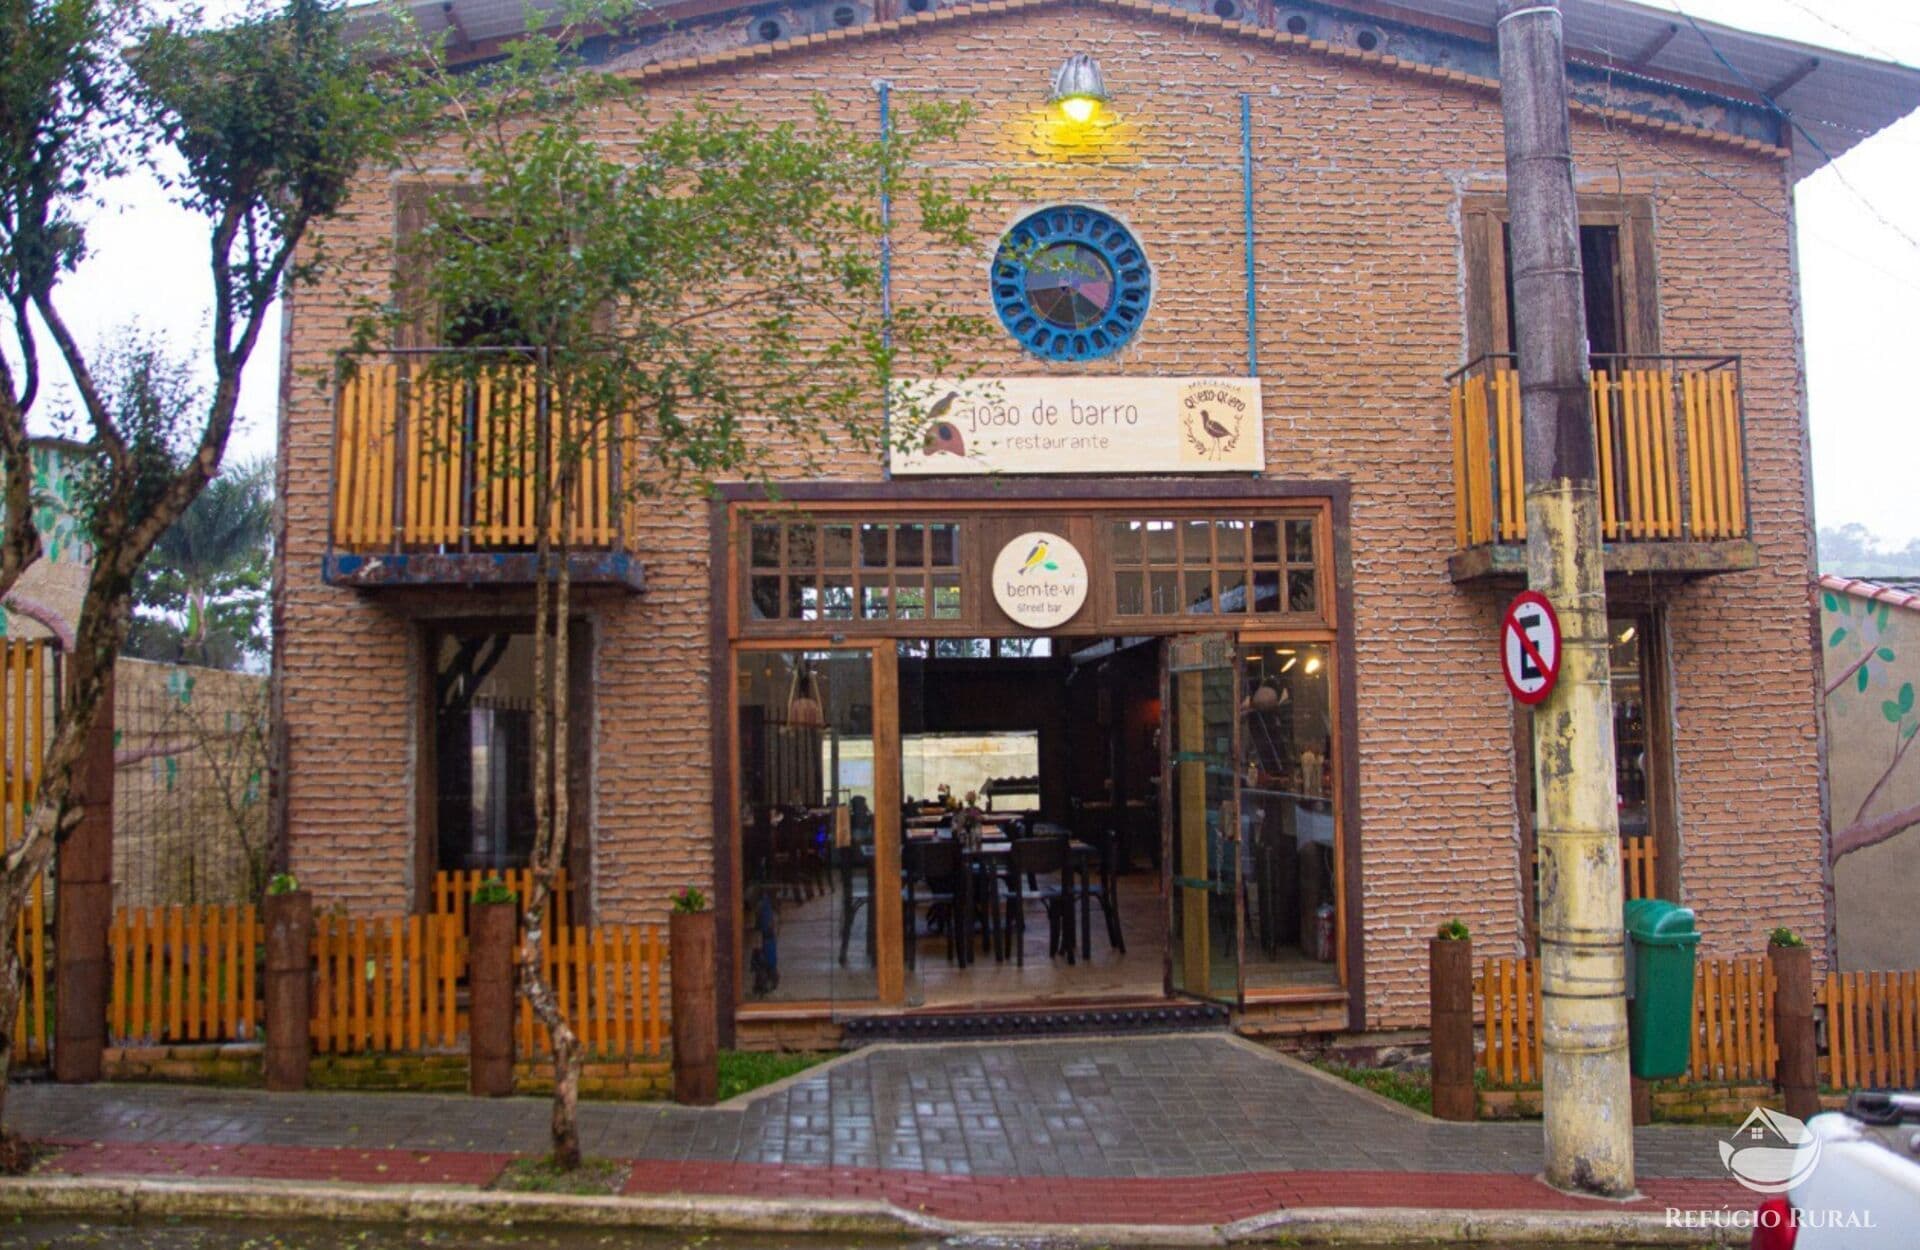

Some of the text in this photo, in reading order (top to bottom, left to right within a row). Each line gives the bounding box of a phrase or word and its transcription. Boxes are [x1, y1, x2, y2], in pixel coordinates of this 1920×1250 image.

[1032, 398, 1058, 426] de
[1070, 398, 1138, 426] barro
[1006, 433, 1109, 450] restaurante
[1519, 614, 1543, 680] E
